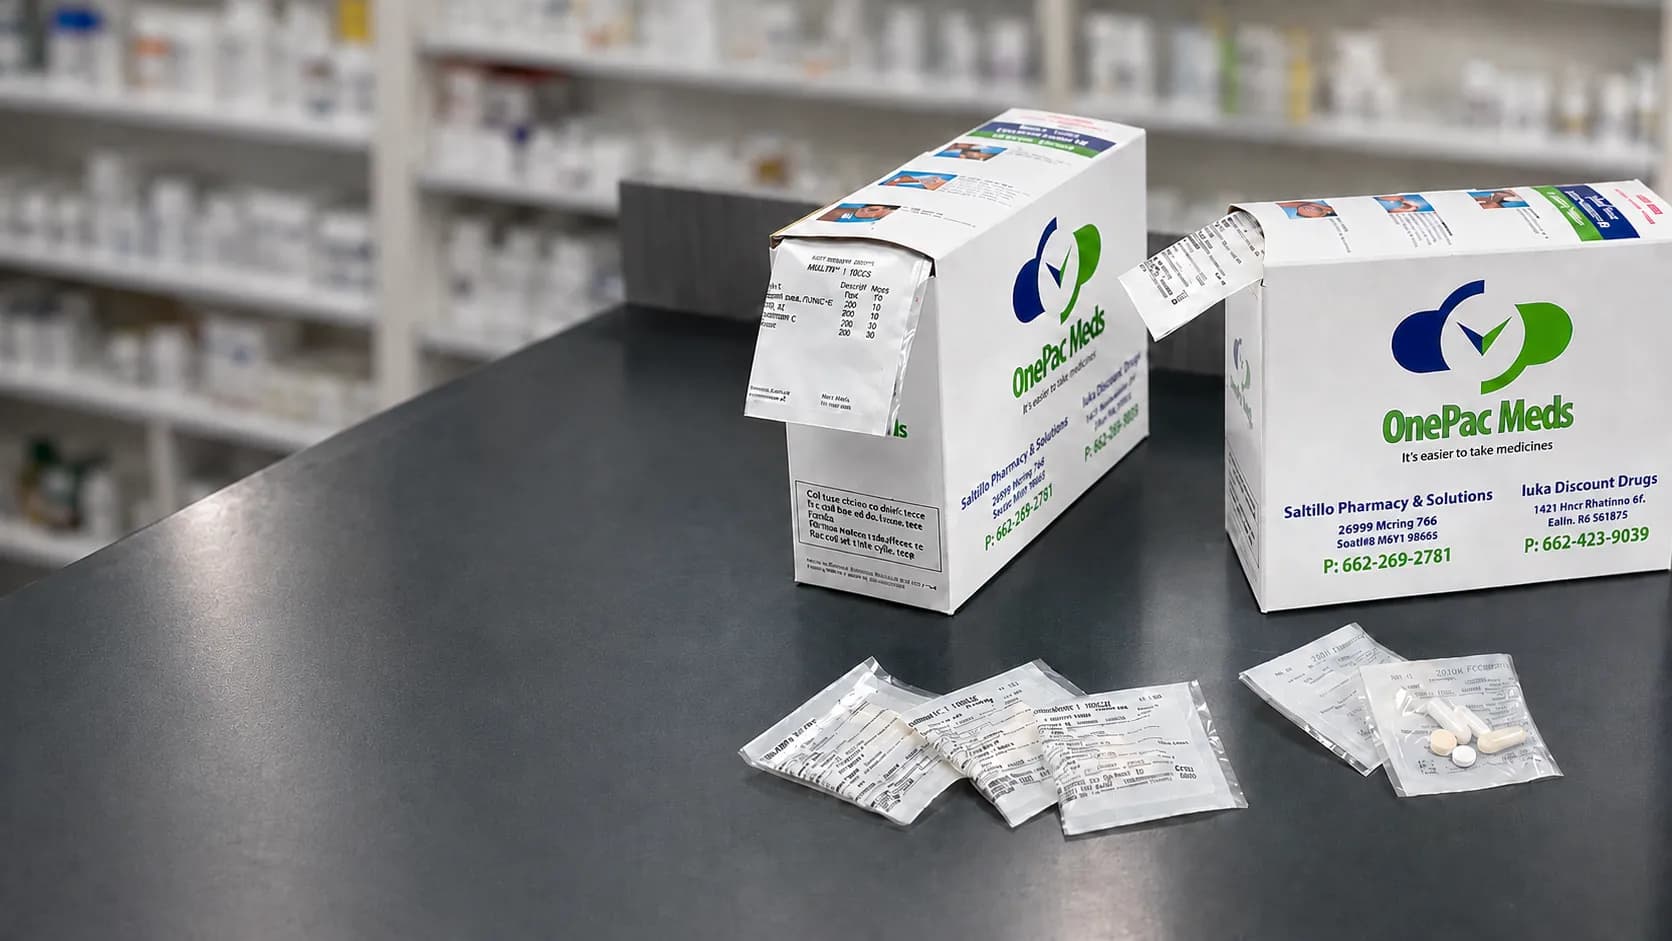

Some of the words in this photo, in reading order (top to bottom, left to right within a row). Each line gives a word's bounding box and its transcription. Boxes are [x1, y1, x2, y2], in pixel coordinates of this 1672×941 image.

[1013, 338, 1067, 398] OnePac
[1070, 305, 1105, 358] Meds
[1383, 404, 1492, 443] OnePac
[1498, 395, 1574, 433] Meds
[961, 481, 990, 510] Saltillo
[991, 450, 1028, 486] Pharmacy
[1029, 443, 1035, 456] &
[1036, 417, 1068, 451] Solutions
[1402, 452, 1418, 463] It's
[1420, 450, 1454, 461] easier
[1456, 448, 1468, 458] to
[1470, 445, 1494, 457] take
[1496, 441, 1553, 455] medicines
[1555, 477, 1615, 494] Discount
[1618, 474, 1658, 488] Drugs
[985, 534, 994, 551] P:
[996, 482, 1053, 542] 662-269-2781
[1284, 503, 1334, 519] Saltillo
[1338, 498, 1409, 514] Pharmacy
[1412, 495, 1424, 507] &
[1426, 490, 1493, 506] Solutions
[1534, 503, 1557, 514] 1421
[1338, 522, 1373, 535] 26999
[1416, 516, 1438, 527] 766
[1524, 538, 1538, 553] P:
[1542, 526, 1650, 551] 662-423-9039
[1324, 559, 1338, 574] P:
[1342, 548, 1451, 573] 662-269-2781
